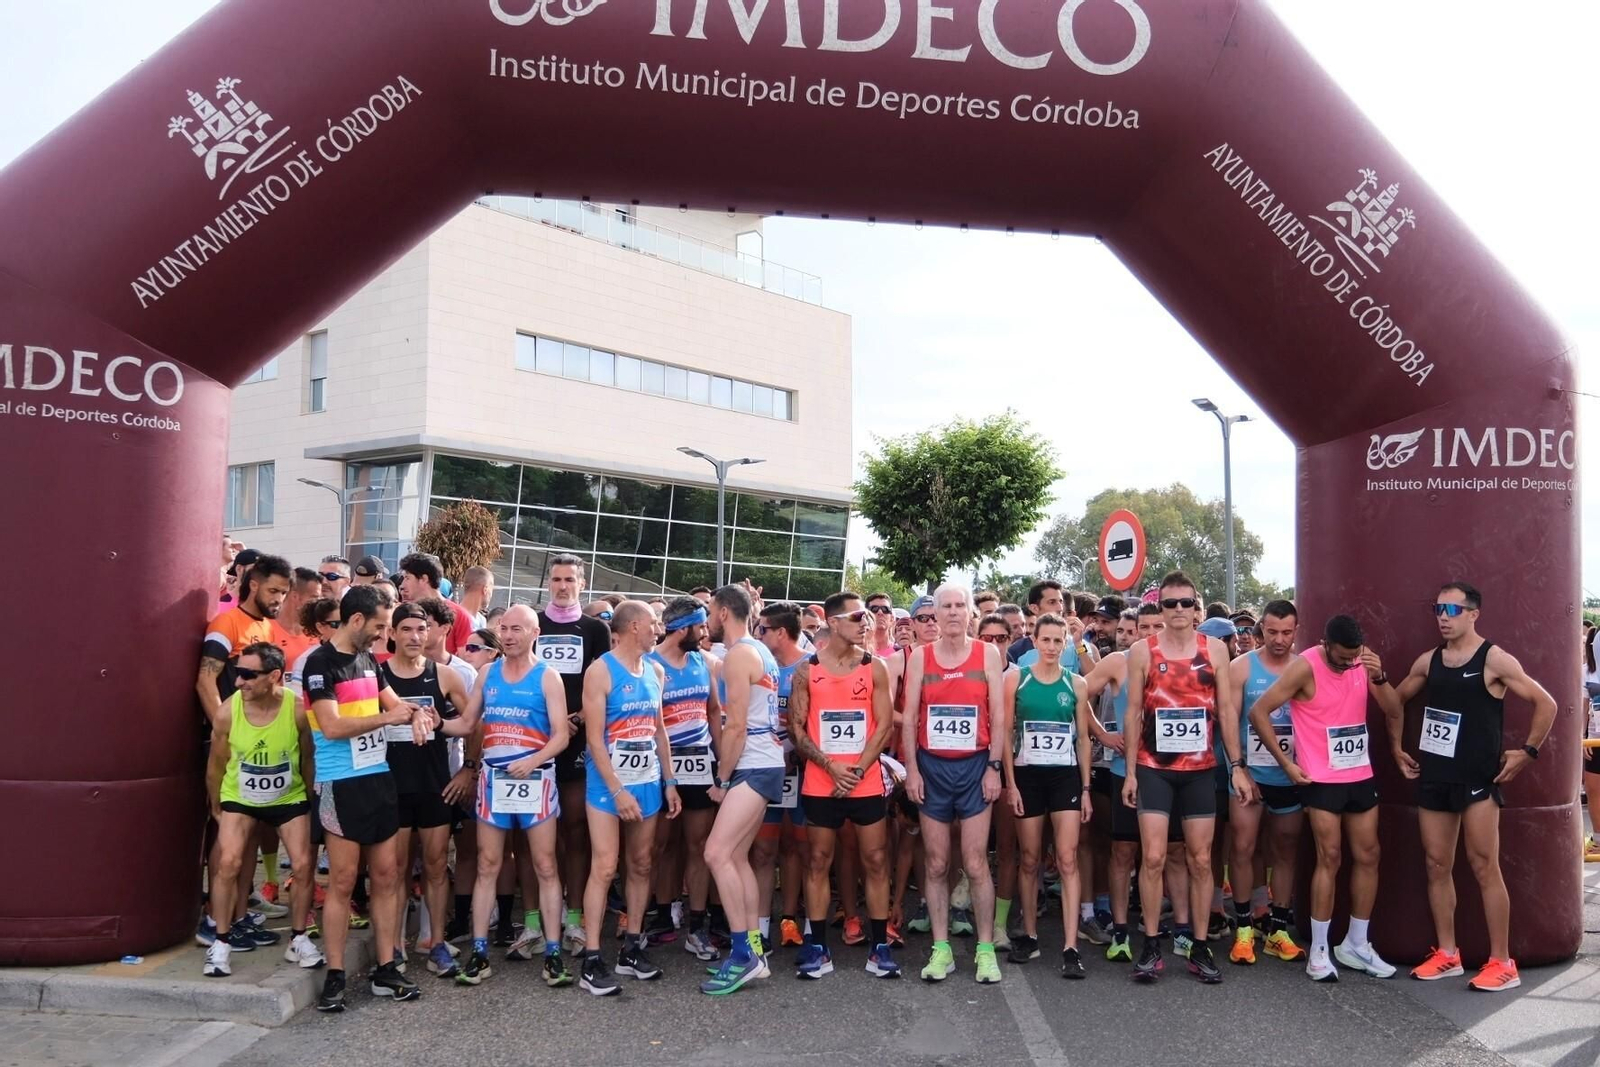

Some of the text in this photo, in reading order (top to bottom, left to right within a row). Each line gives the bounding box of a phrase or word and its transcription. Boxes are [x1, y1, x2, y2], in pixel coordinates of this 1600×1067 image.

[489, 48, 1140, 129] Instituto Municipal de Deportes Córdoba
[130, 75, 424, 309] AYUNTAMIENTO DE CÓRDOBA
[1203, 142, 1435, 387] AYUNTAMIENTO DE CÓRDOBA
[15, 401, 37, 416] de
[41, 403, 119, 424] Deportes
[122, 412, 181, 431] Córdoba
[1433, 427, 1579, 470] IMDEC
[1367, 478, 1423, 491] Instituto
[1426, 477, 1498, 492] Municipal
[1501, 477, 1519, 490] de
[1521, 478, 1567, 492] Deportes
[542, 646, 578, 660] 652
[662, 685, 710, 700] enerplus
[621, 699, 660, 712] enerplu
[830, 724, 856, 739] 94
[933, 719, 971, 735] 448
[1162, 722, 1202, 737] 394
[1426, 723, 1451, 741] 452
[358, 731, 384, 751] 314
[1031, 735, 1066, 750] 137
[1253, 738, 1289, 752] 76
[1333, 738, 1365, 754] 404
[618, 754, 650, 769] 701
[673, 759, 706, 773] 705
[245, 775, 286, 791] 400
[505, 783, 530, 798] 78
